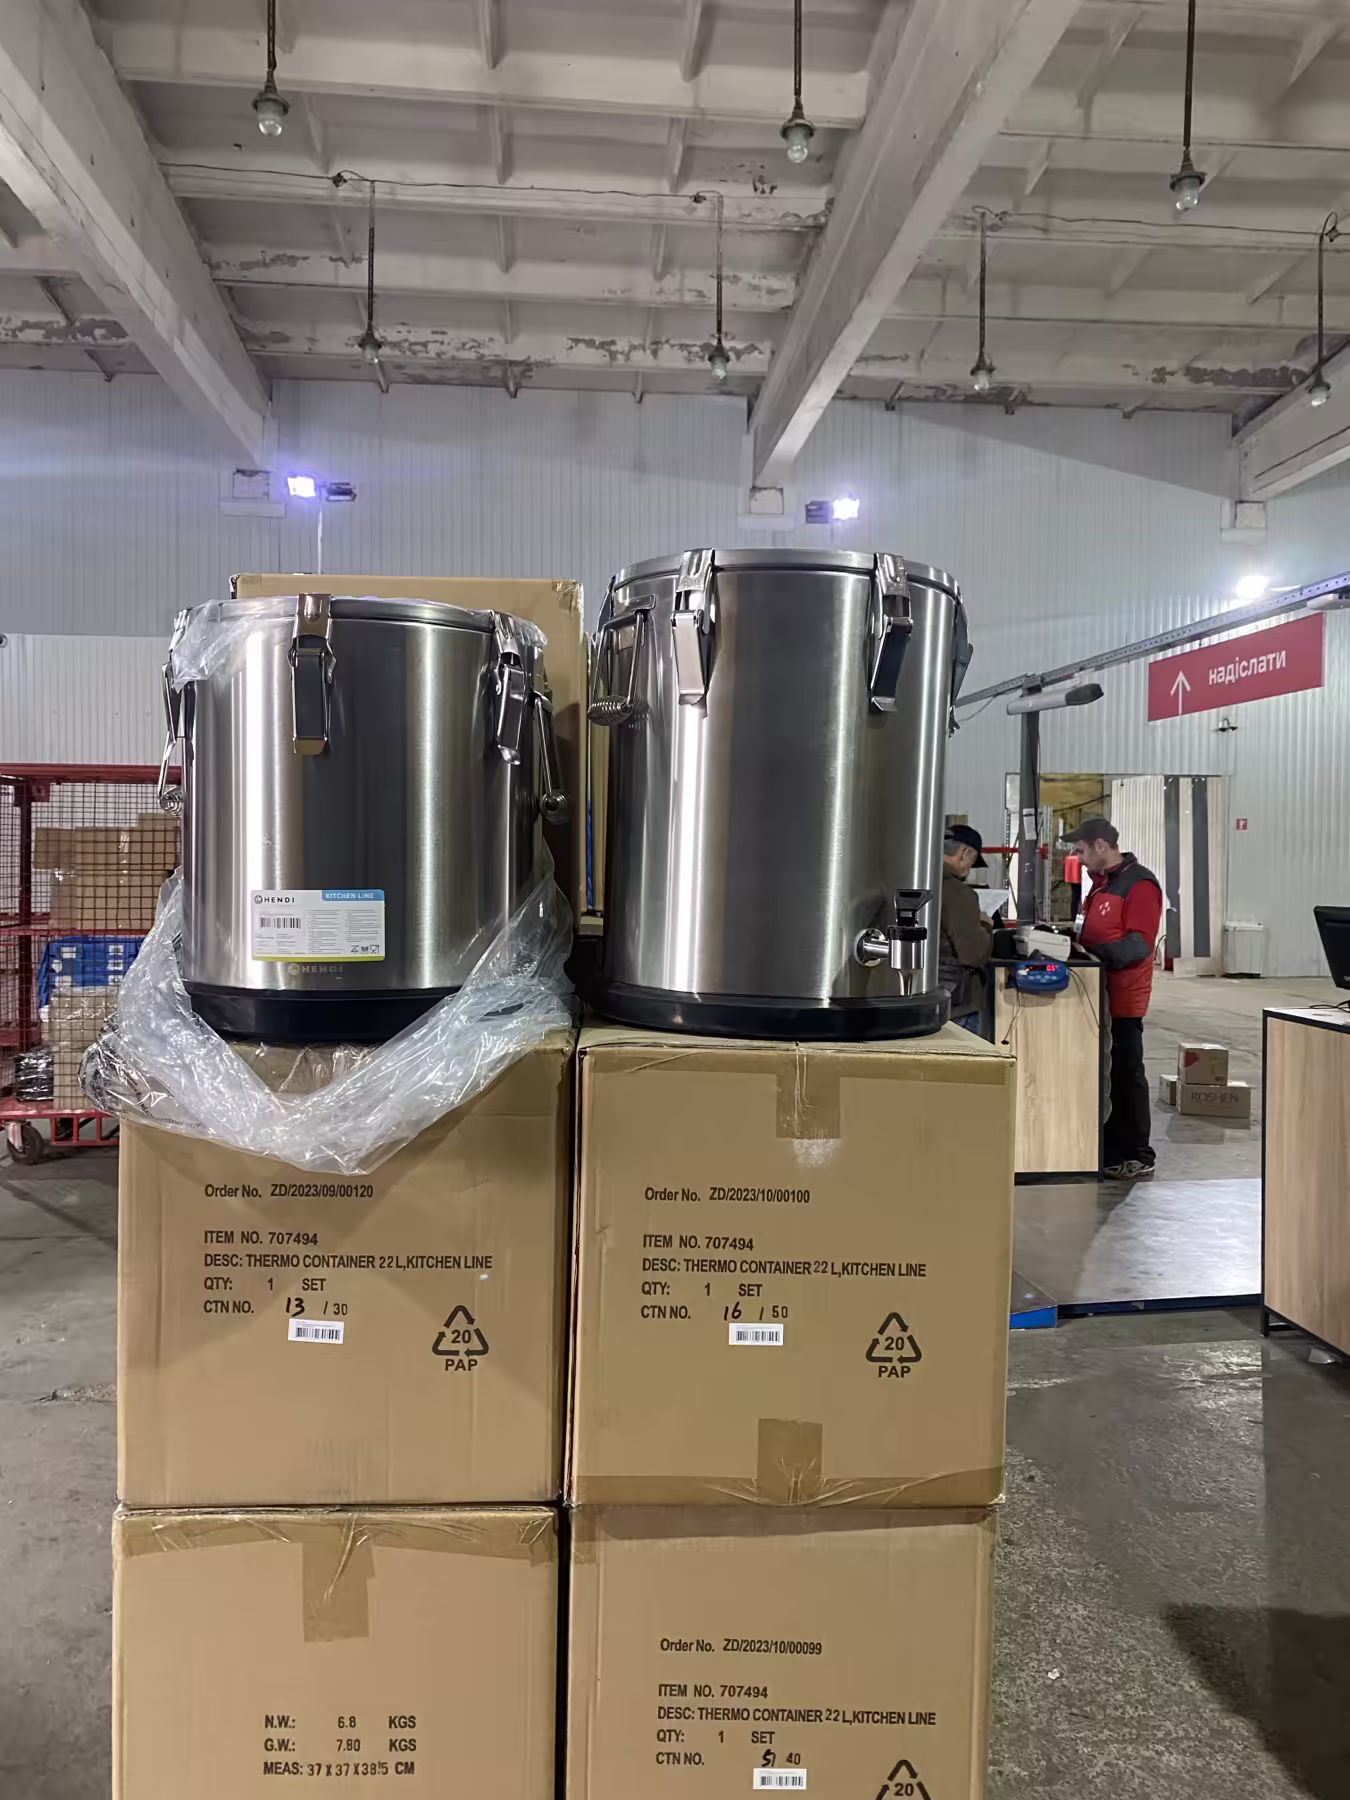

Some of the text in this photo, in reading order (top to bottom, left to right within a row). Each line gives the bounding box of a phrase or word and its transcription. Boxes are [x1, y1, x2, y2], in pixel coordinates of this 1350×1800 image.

[1208, 650, 1286, 685] надіслати
[204, 1183, 374, 1199] Order No. ZD/2023/09/00120
[644, 1186, 811, 1204] Order No. ZD/2023/10/00100
[203, 1229, 319, 1246] ITEM NO. 707494
[642, 1233, 755, 1252] ITEM NO. 707494
[203, 1253, 243, 1268] DESC:
[244, 1253, 301, 1268] THERMO
[302, 1254, 377, 1269] CONTAINER
[378, 1255, 394, 1269] 22
[463, 1255, 493, 1270] LINE
[642, 1257, 681, 1273] DESC:
[682, 1258, 738, 1274] THERMO
[739, 1259, 813, 1276] CONTAINER
[810, 1260, 829, 1275] 22
[897, 1262, 927, 1278] LINE
[203, 1276, 327, 1292] QTY: 1 SET
[641, 1280, 764, 1298] QTY: 1 SET
[203, 1299, 230, 1314] CTN
[231, 1300, 255, 1314] NO.
[285, 1296, 306, 1318] 13
[332, 1302, 348, 1316] 30
[640, 1304, 667, 1320] CTN
[668, 1305, 692, 1320] NO.
[723, 1300, 742, 1323] 16
[771, 1304, 789, 1319] 50
[451, 1329, 472, 1344] 20
[884, 1336, 904, 1351] 20
[444, 1356, 479, 1372] PAP
[877, 1362, 912, 1379] PAP
[659, 1637, 823, 1656] Order No. ZD/2023/10/00099
[658, 1683, 769, 1699] ITEM NO. 707494
[264, 1714, 417, 1730] N.W.: 6.8 KGS
[657, 1705, 696, 1721] DESC:
[696, 1706, 751, 1722] THERMO
[752, 1707, 824, 1723] CONTAINER
[824, 1707, 841, 1723] 22
[907, 1711, 937, 1726] LINE
[263, 1737, 417, 1753] G.W.: 7.80 KGS
[656, 1728, 776, 1745] QTY: 1 SET
[655, 1751, 681, 1766] CTN
[683, 1751, 705, 1766] NO.
[785, 1751, 802, 1766] 40
[262, 1760, 304, 1776] MEAS:
[306, 1762, 323, 1777] 37
[334, 1762, 351, 1777] 37
[394, 1760, 415, 1776] CM
[894, 1782, 914, 1796] 20
